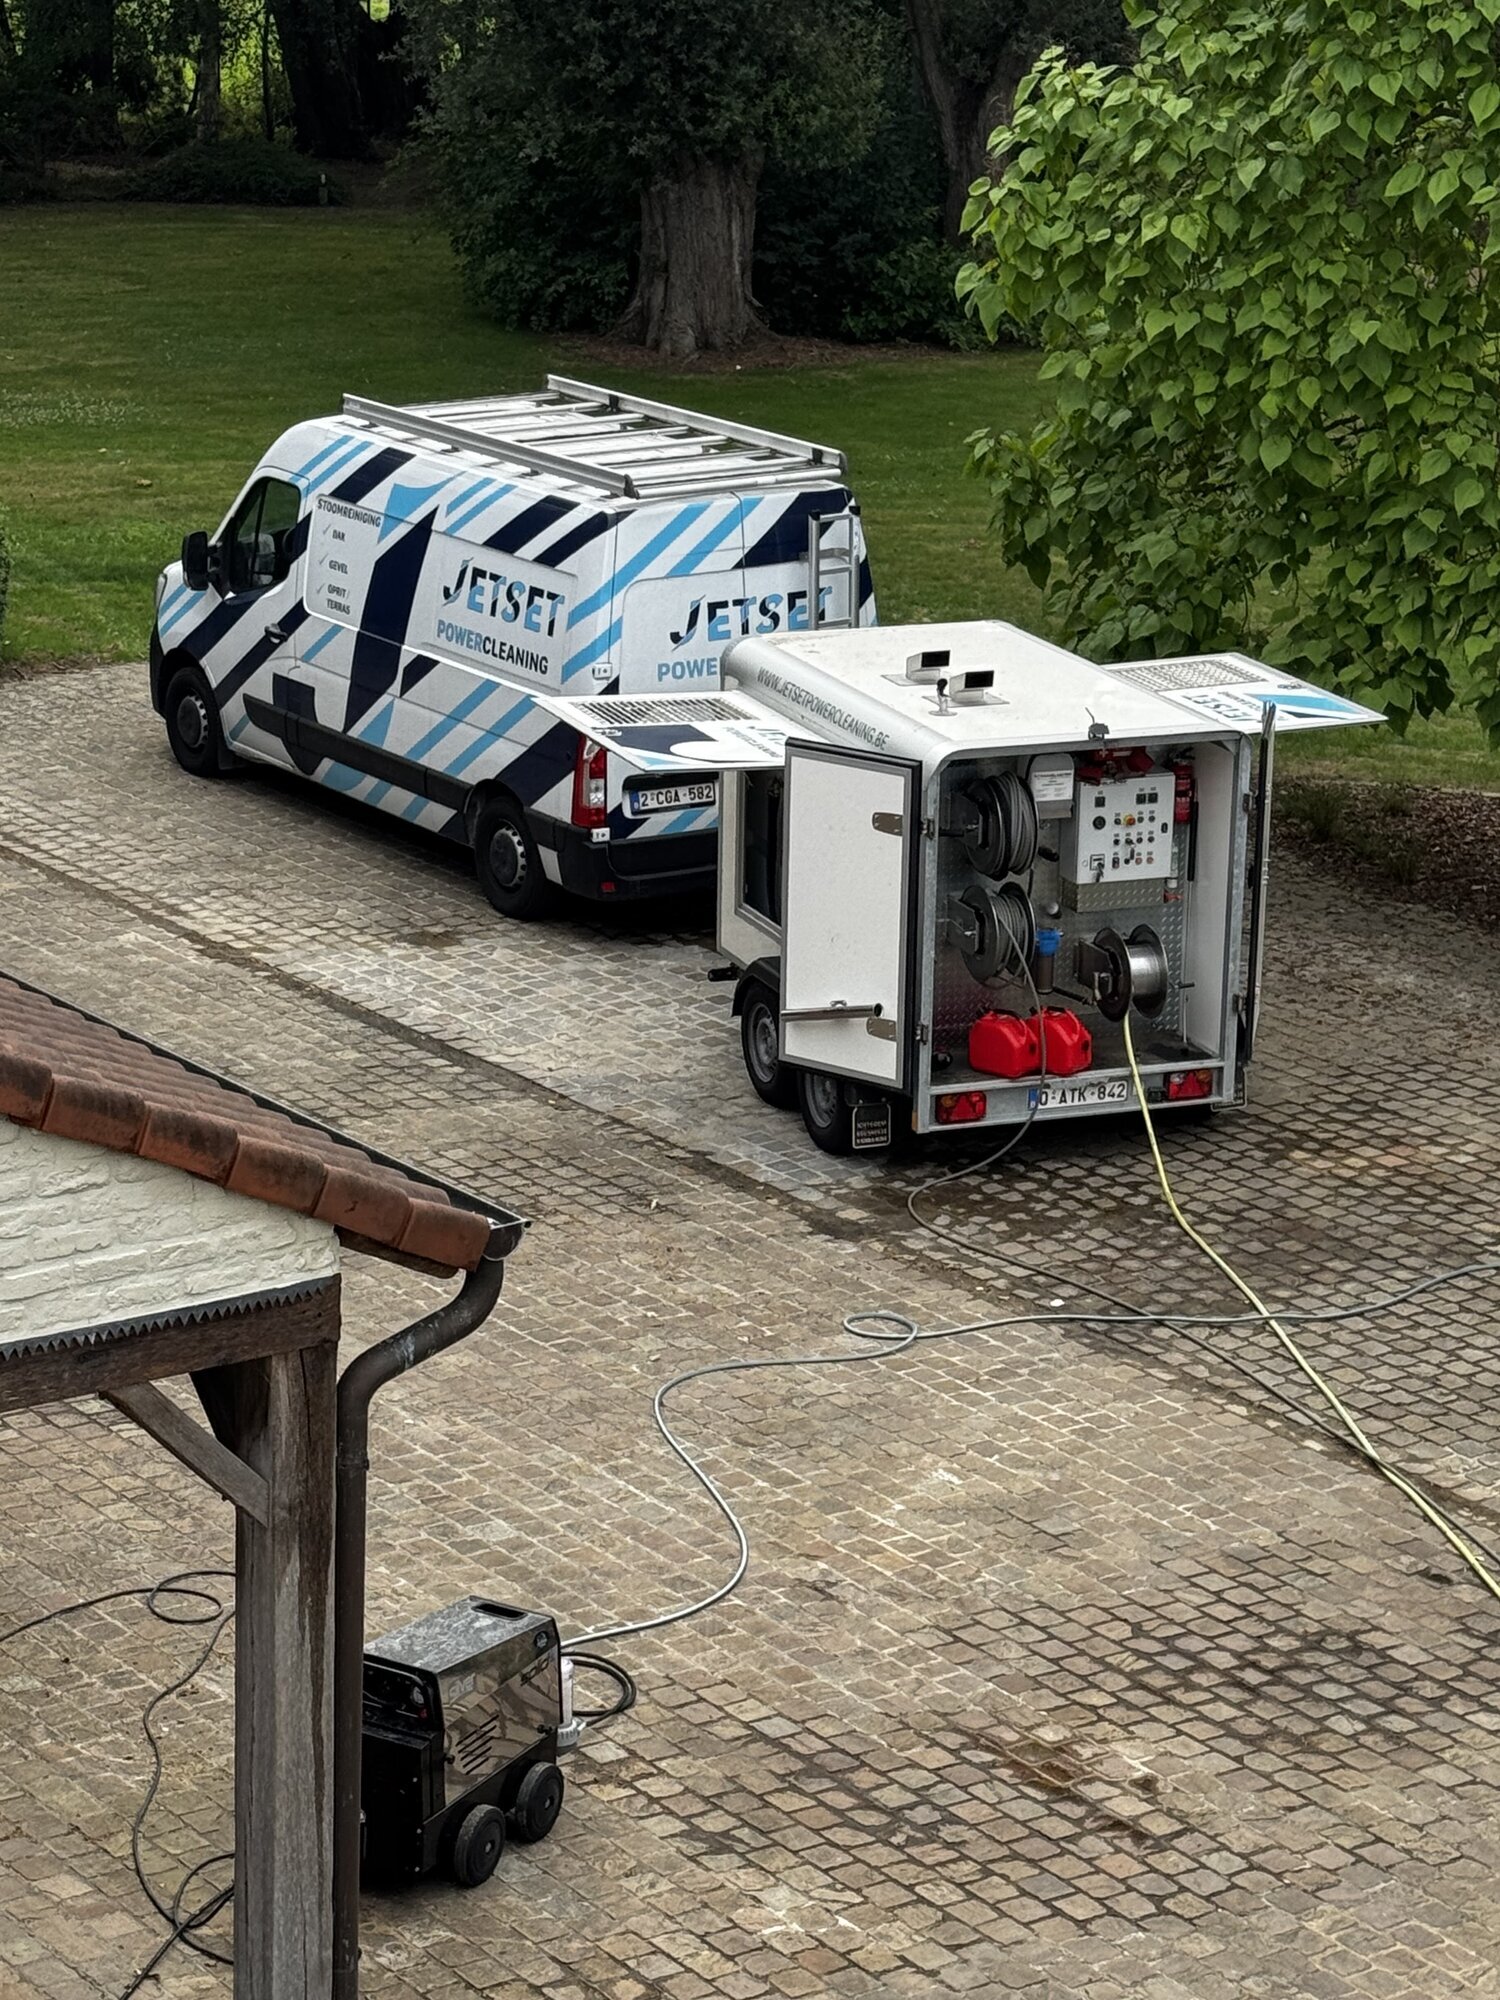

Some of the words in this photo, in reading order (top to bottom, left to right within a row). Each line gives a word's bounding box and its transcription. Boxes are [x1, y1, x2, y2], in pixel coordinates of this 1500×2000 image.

[317, 498, 381, 528] STOOMREINIGING
[443, 557, 566, 637] JETSET
[436, 619, 549, 675] POWERCLEANING
[756, 666, 890, 751] WWW.JETSETPOWERCLEANING.BE
